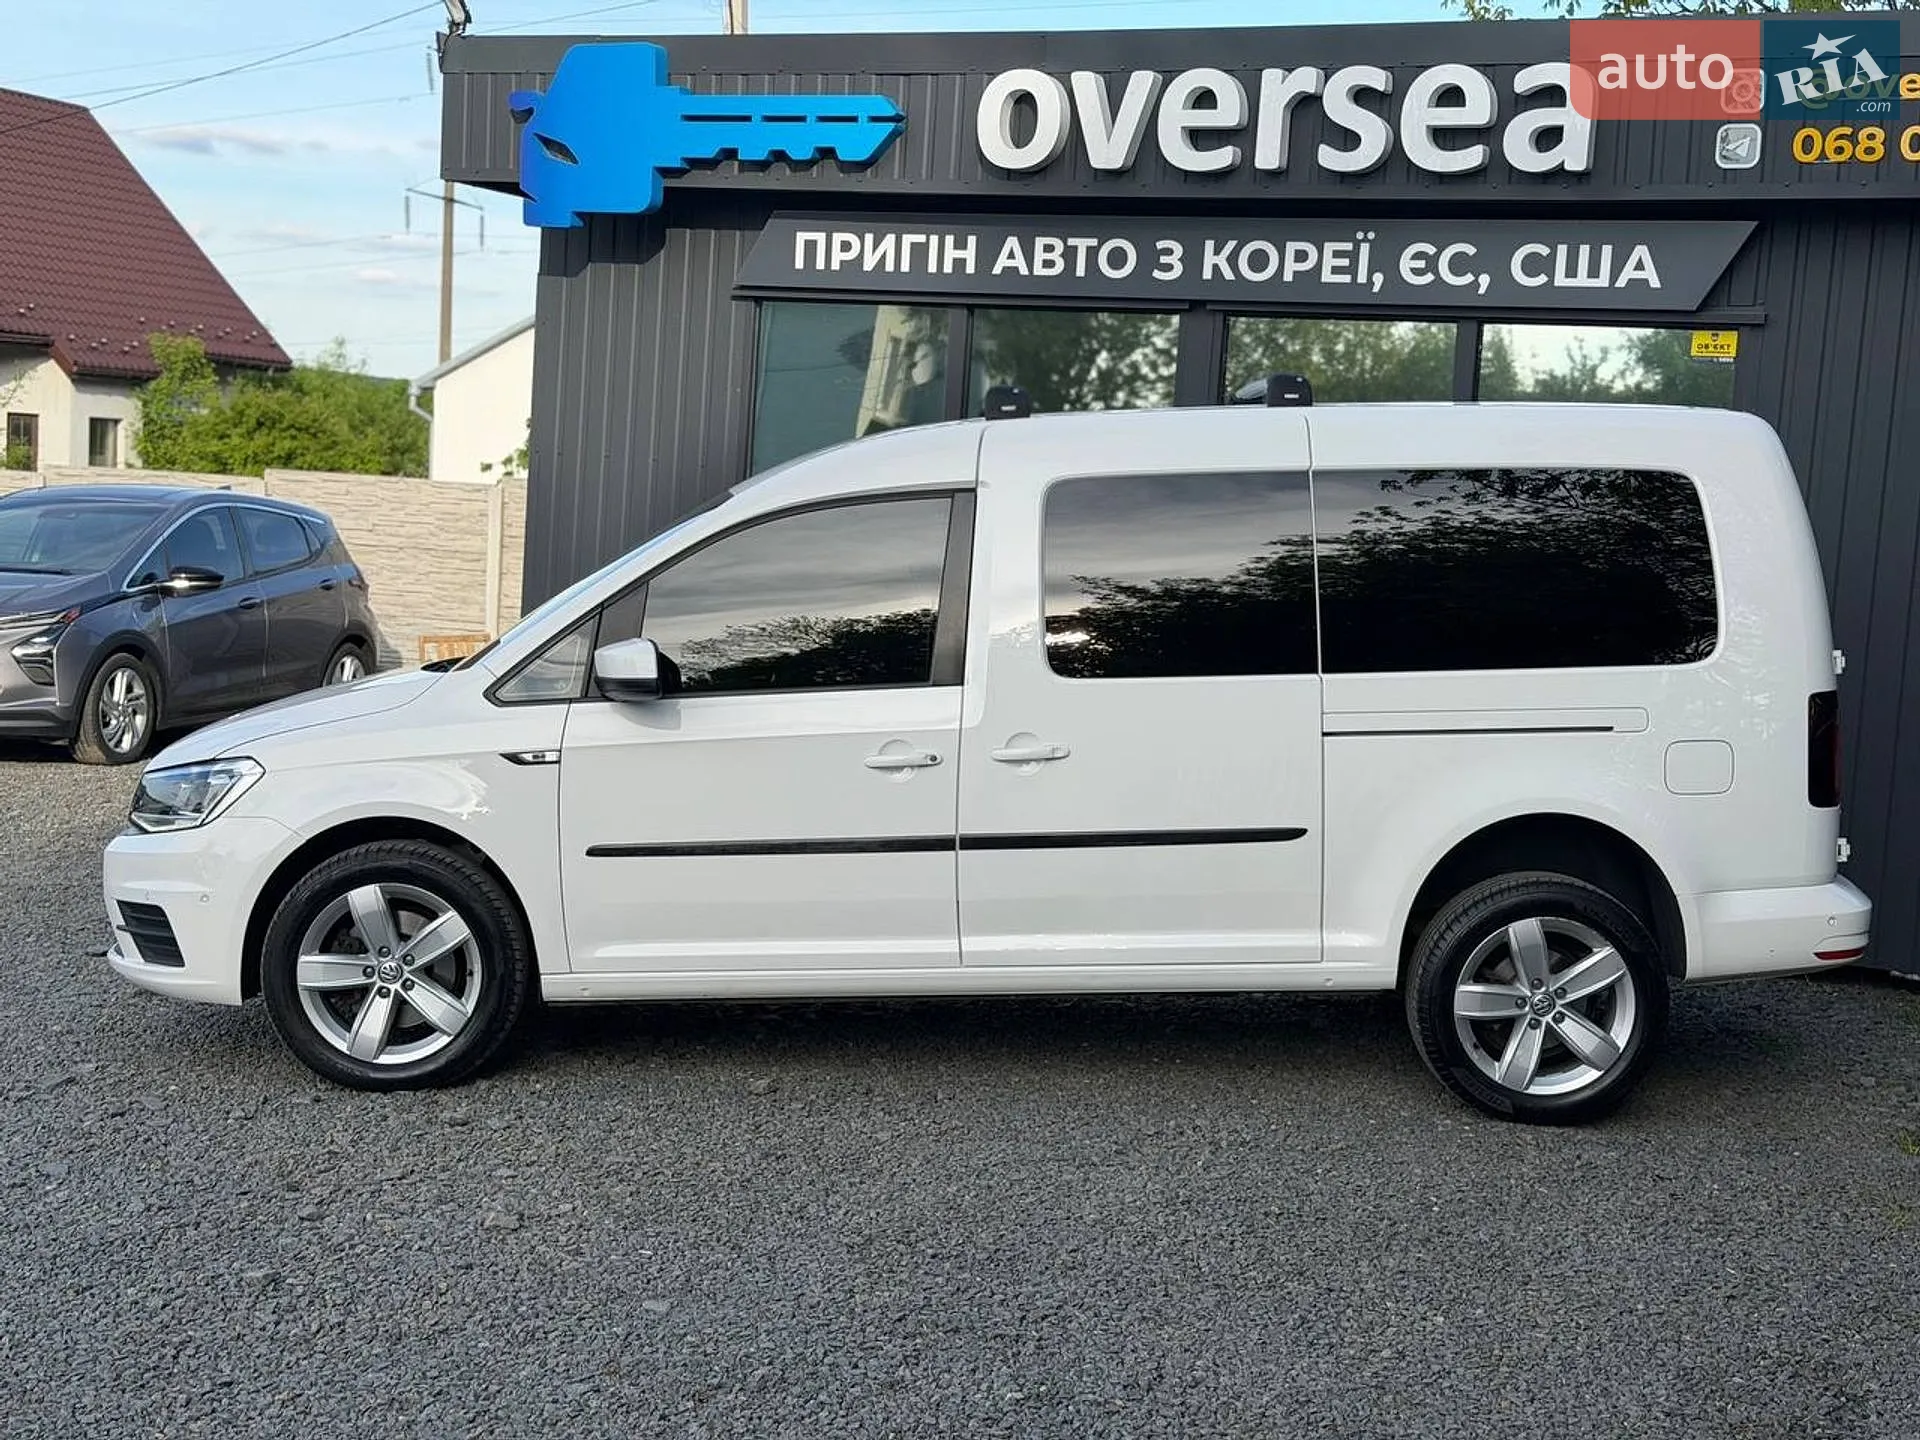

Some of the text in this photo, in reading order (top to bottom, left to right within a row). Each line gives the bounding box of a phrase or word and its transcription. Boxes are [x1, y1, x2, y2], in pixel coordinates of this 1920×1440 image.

[976, 61, 1596, 174] oversea
[1792, 125, 1886, 163] 068
[794, 231, 1662, 294] ПРИГІН АВТО З КОРЕЇ, ЄС, США
